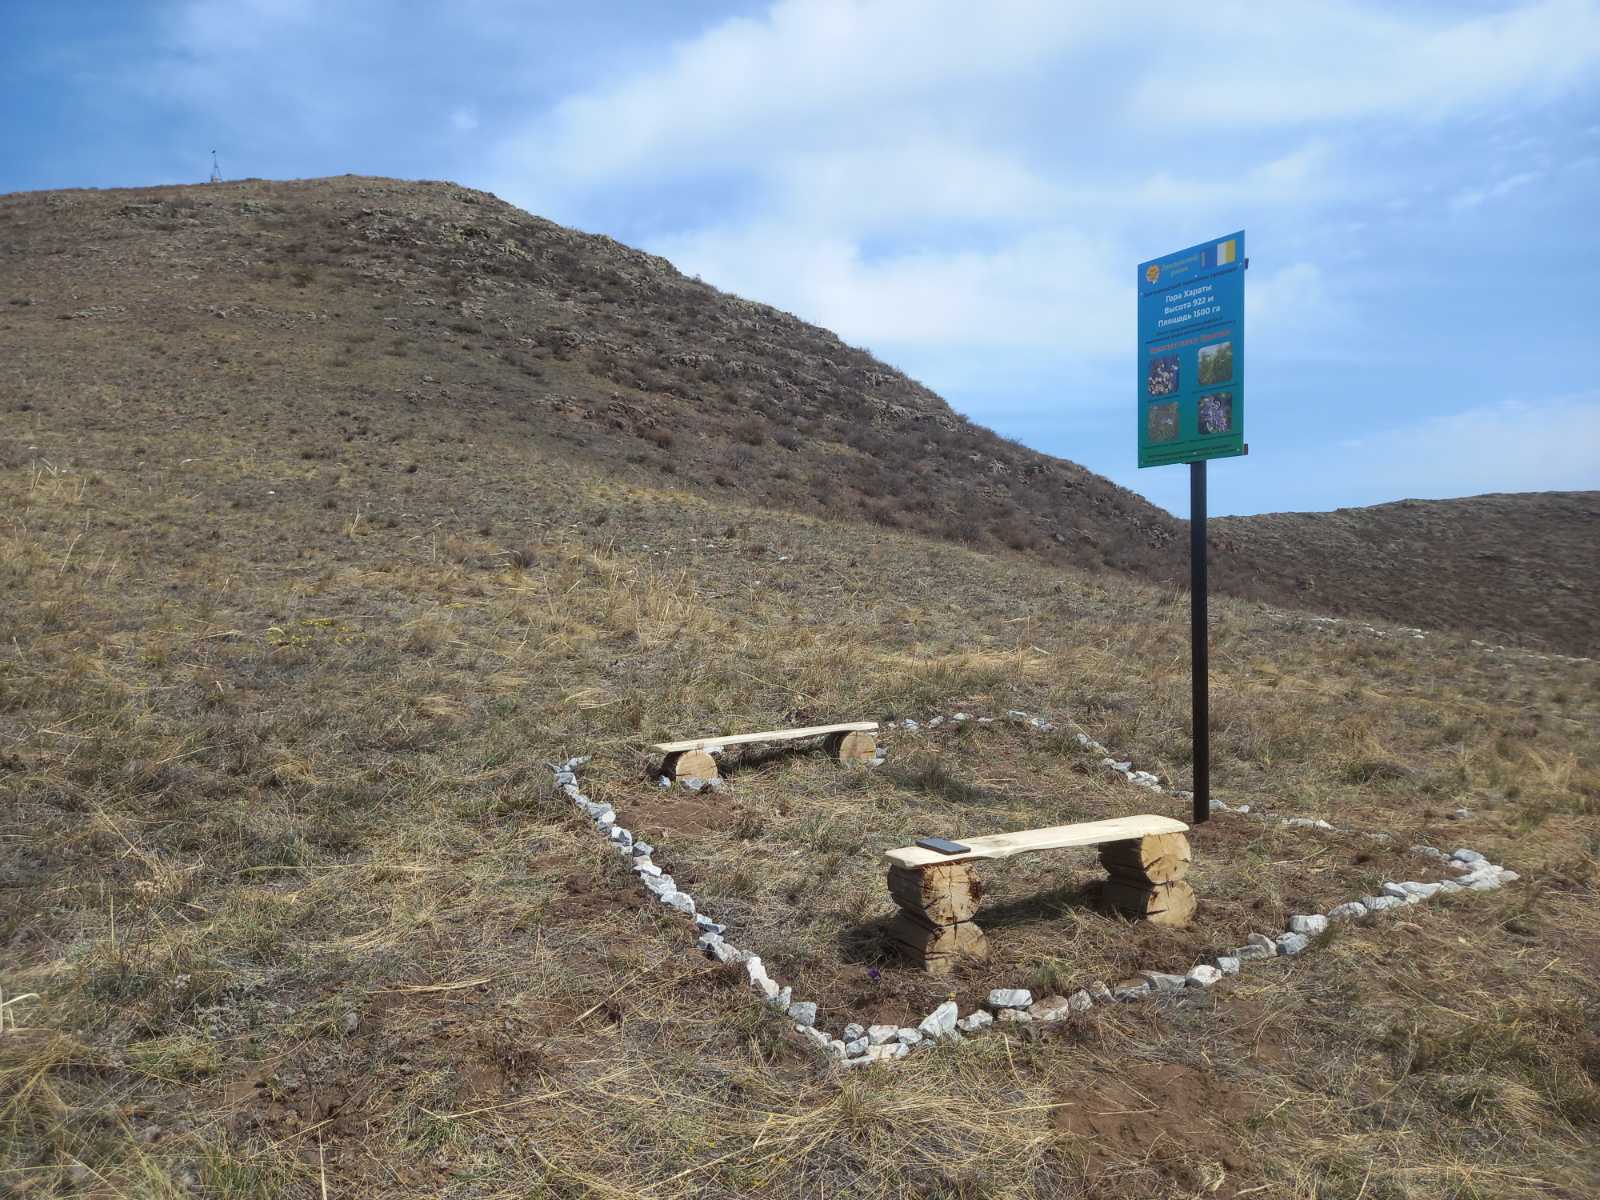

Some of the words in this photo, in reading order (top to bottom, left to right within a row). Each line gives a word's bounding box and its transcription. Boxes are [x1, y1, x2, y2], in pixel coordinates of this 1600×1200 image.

[1165, 293, 1182, 303] Гора
[1164, 303, 1191, 314] Высота
[1158, 313, 1192, 327] Площадь
